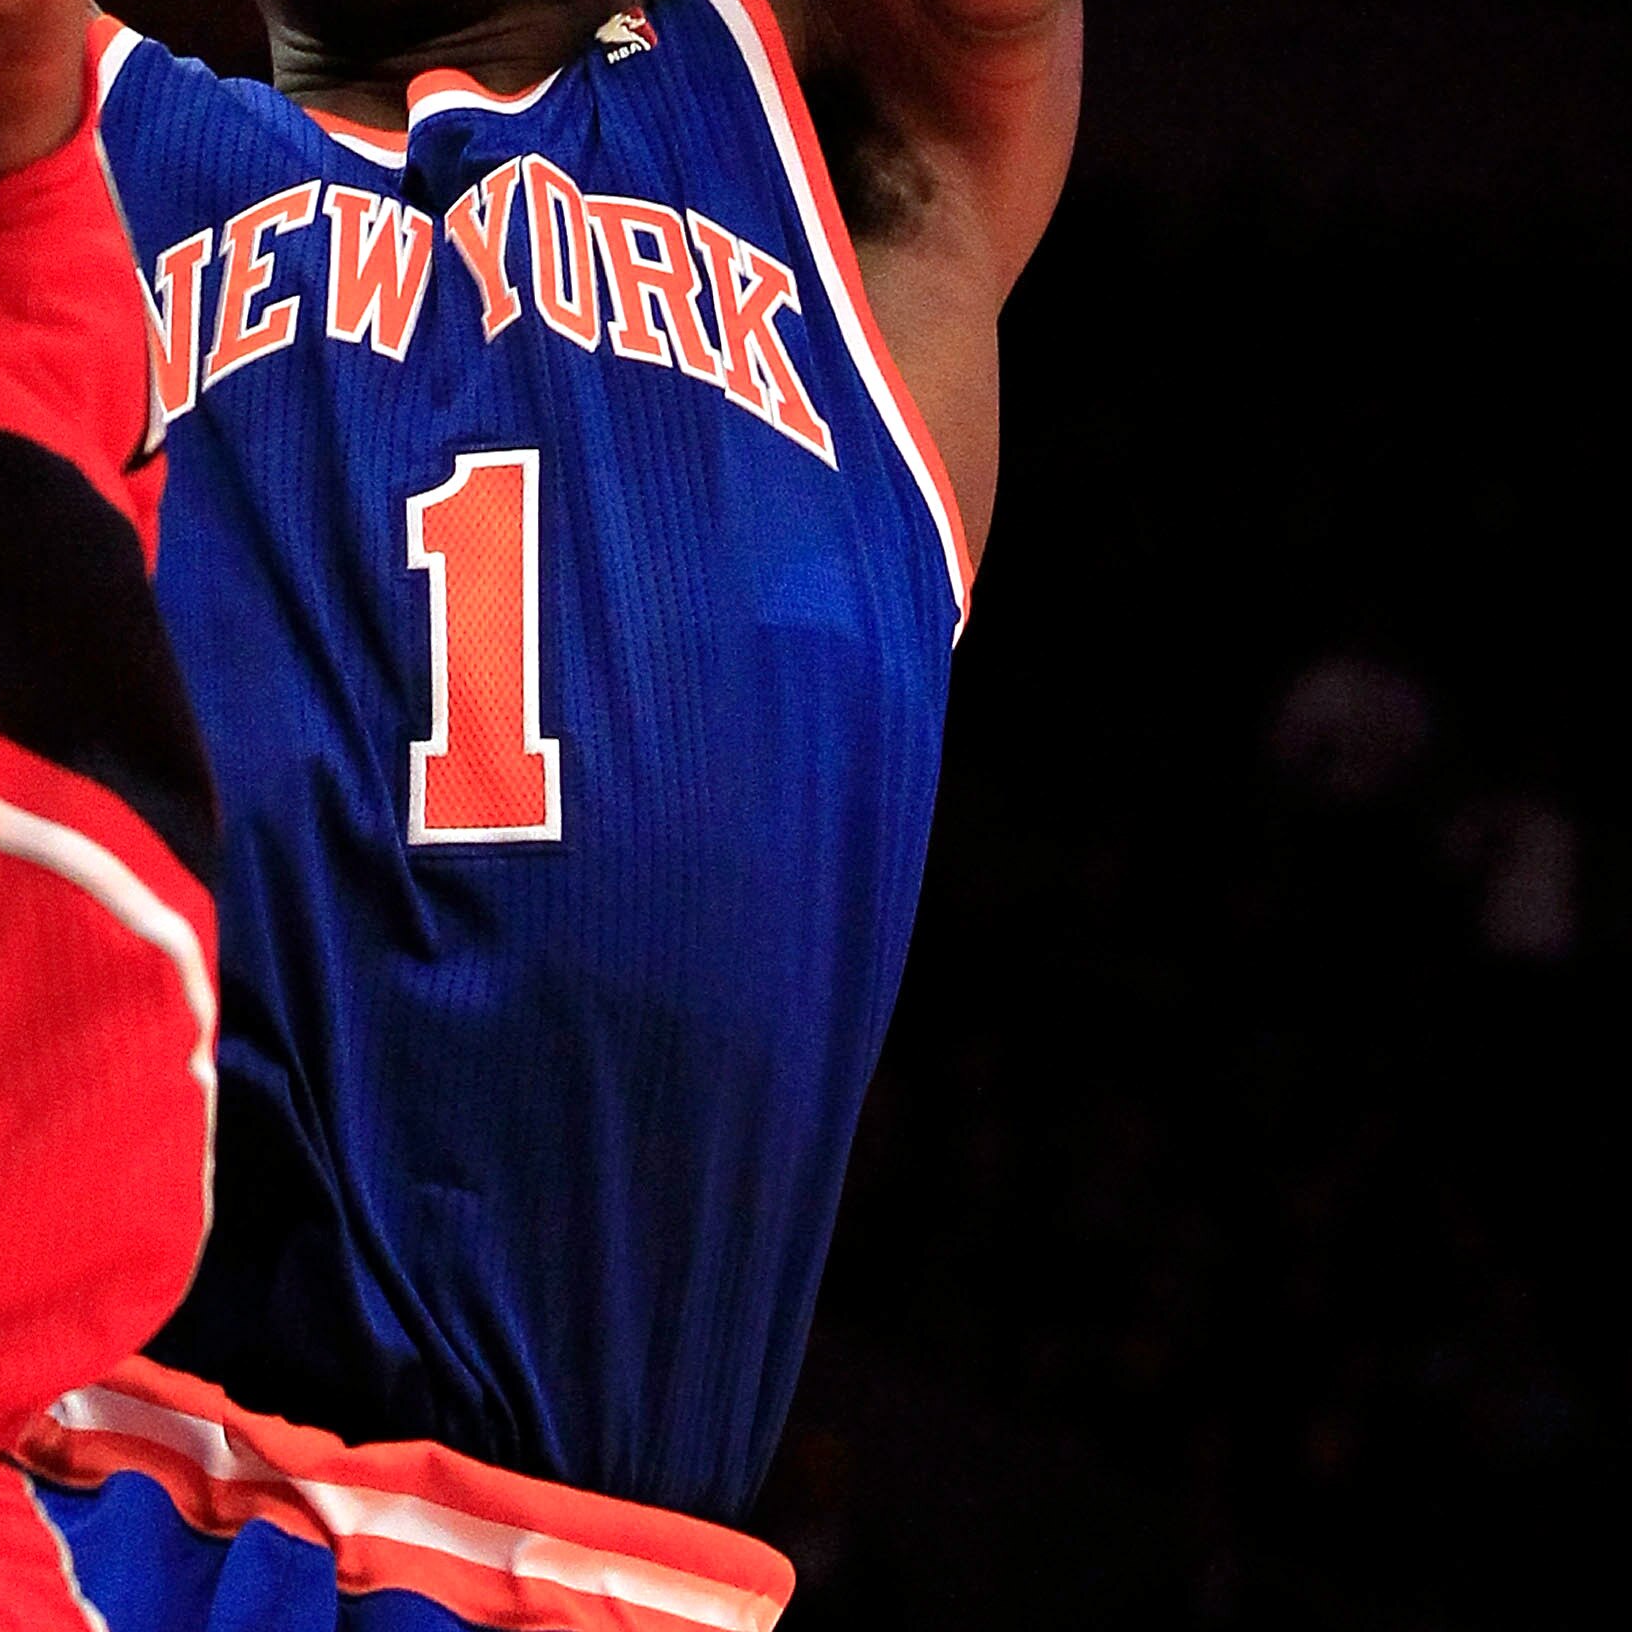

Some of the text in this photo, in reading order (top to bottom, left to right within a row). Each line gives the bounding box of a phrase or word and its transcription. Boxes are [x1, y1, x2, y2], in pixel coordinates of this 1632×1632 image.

[607, 41, 643, 65] NBA
[135, 153, 839, 471] NEW YORK
[406, 448, 562, 845] 1
